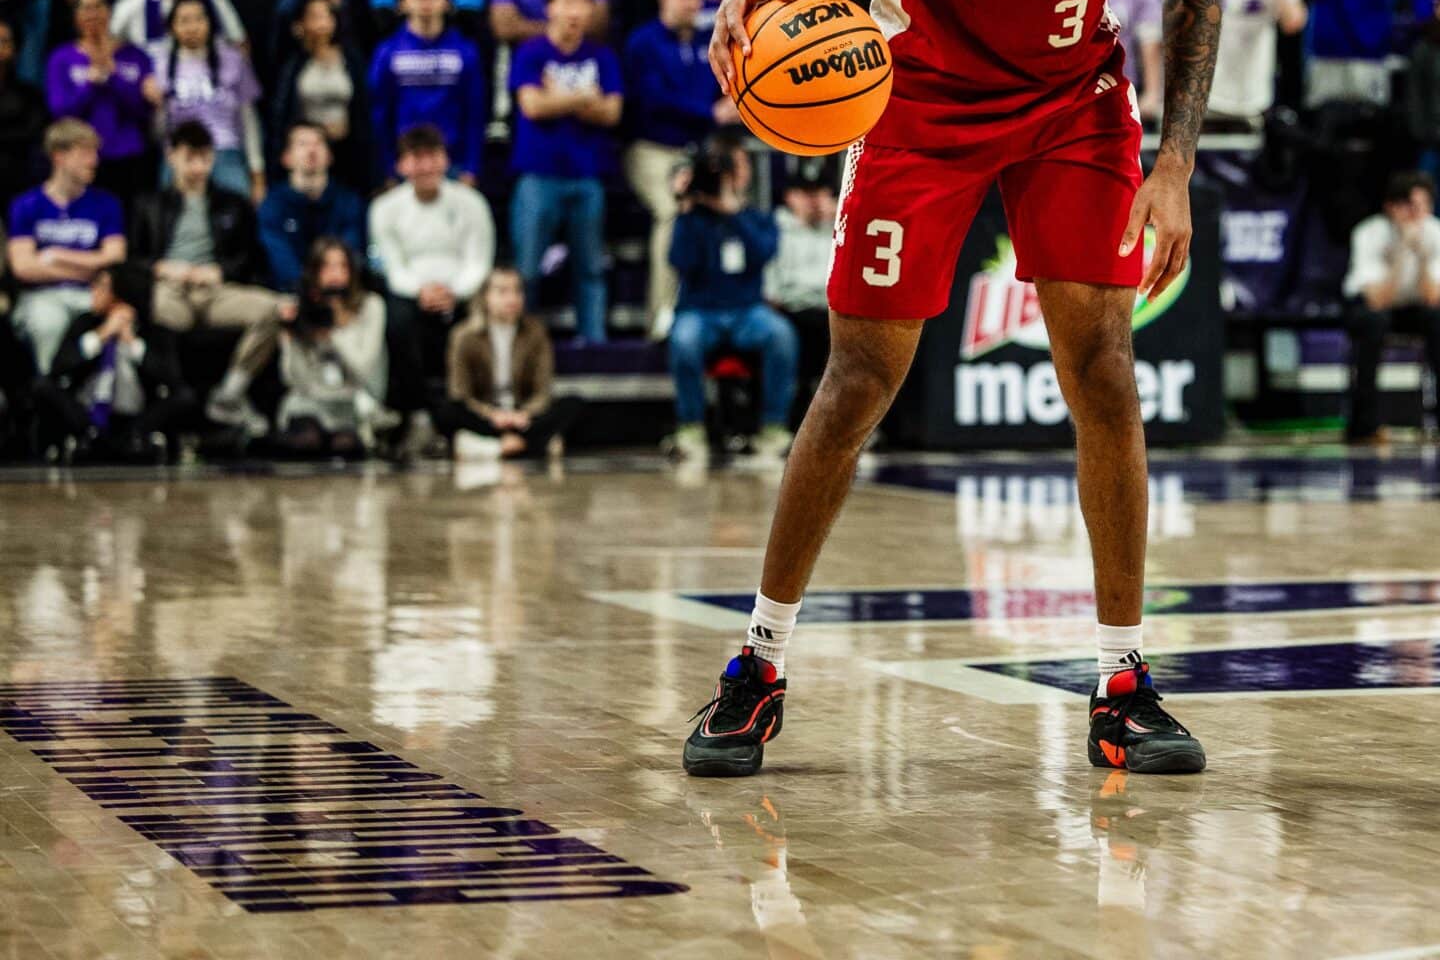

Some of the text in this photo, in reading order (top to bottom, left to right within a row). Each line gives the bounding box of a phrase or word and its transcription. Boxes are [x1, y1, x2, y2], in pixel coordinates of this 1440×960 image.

[780, 2, 853, 38] NCAA
[787, 39, 887, 85] Wilson
[862, 218, 904, 287] 3
